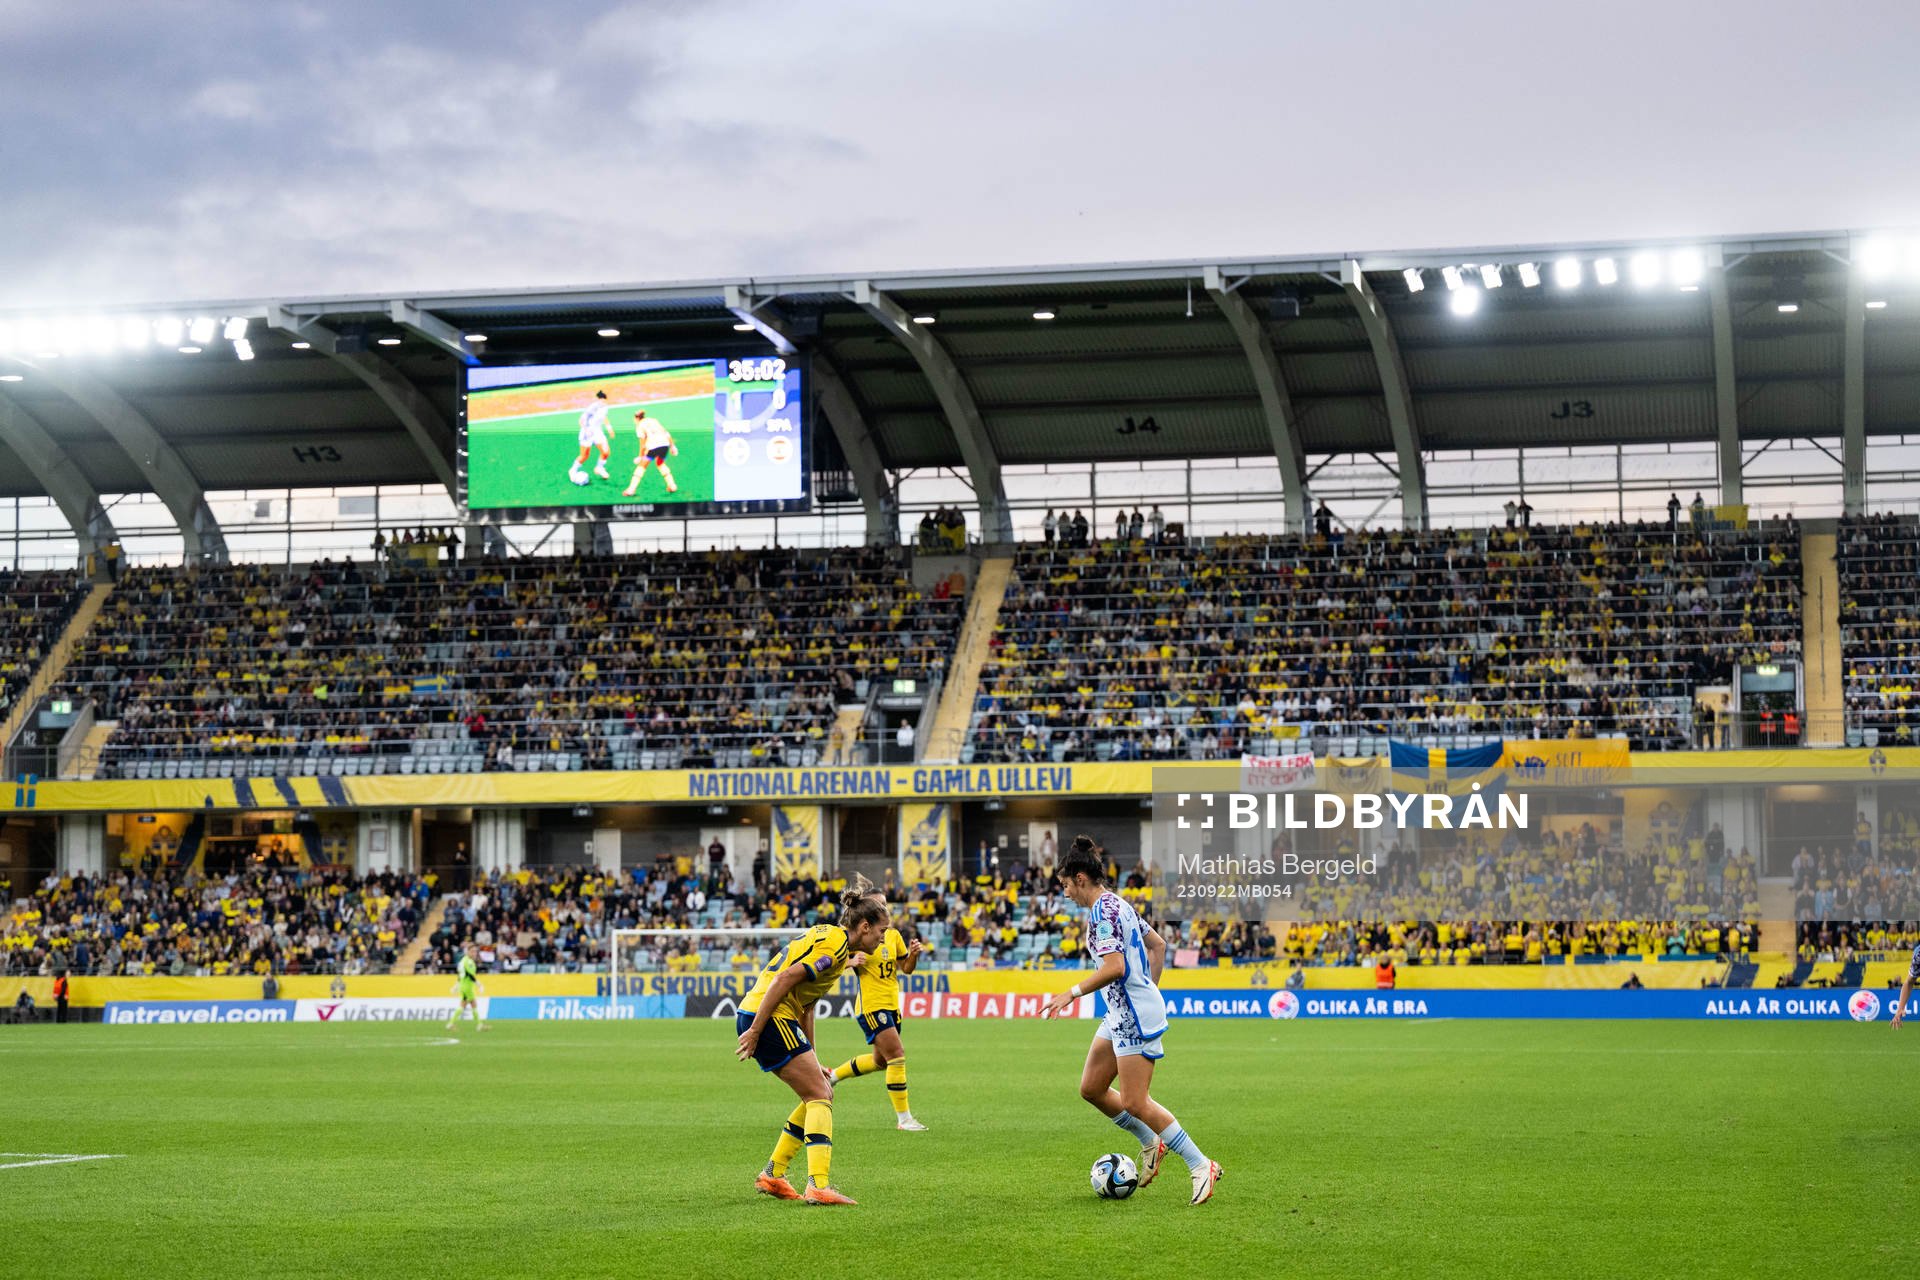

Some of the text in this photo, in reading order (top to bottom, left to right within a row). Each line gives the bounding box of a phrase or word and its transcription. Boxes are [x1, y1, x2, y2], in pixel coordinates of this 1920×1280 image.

[728, 358, 786, 381] 35:02
[772, 388, 786, 410] 0
[1551, 401, 1594, 418] J3
[1116, 416, 1161, 434] J4
[292, 446, 341, 462] H3
[23, 730, 37, 747] H2
[688, 770, 890, 797] NATIONALARENAN
[913, 769, 992, 793] GAMLA
[997, 767, 1072, 792] ULLEVI
[878, 961, 893, 979] 19
[651, 975, 737, 996] SKRIVS
[1182, 997, 1204, 1014] ÄR
[1209, 1000, 1262, 1014] OLIKA
[1306, 997, 1428, 1014] OLIKA ÄR BRA
[1706, 997, 1841, 1015] ALLA ÄR OLIKA
[109, 1006, 288, 1024] latravel.com
